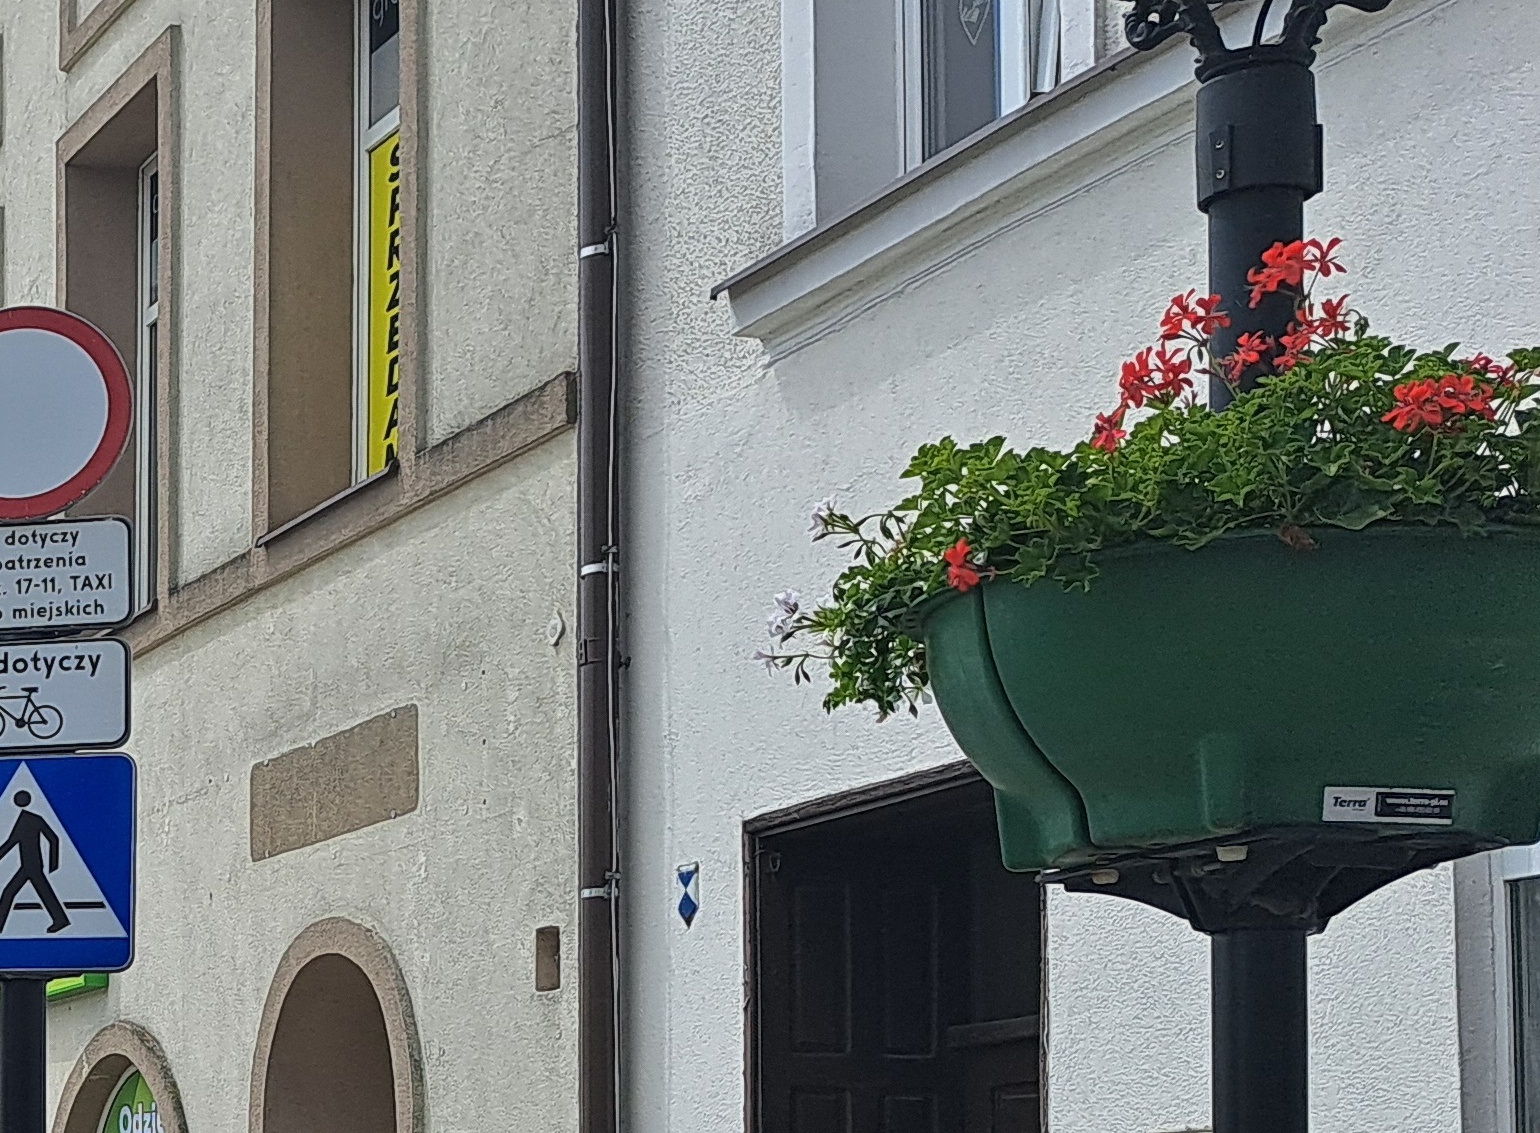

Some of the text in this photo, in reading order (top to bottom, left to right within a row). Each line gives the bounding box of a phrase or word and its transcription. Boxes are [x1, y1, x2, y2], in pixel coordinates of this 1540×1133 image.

[4, 529, 80, 549] dotyczy
[15, 576, 62, 595] 17-11,
[70, 573, 113, 592] TAXI
[12, 599, 105, 621] miejskich
[1332, 796, 1370, 808] Terra
